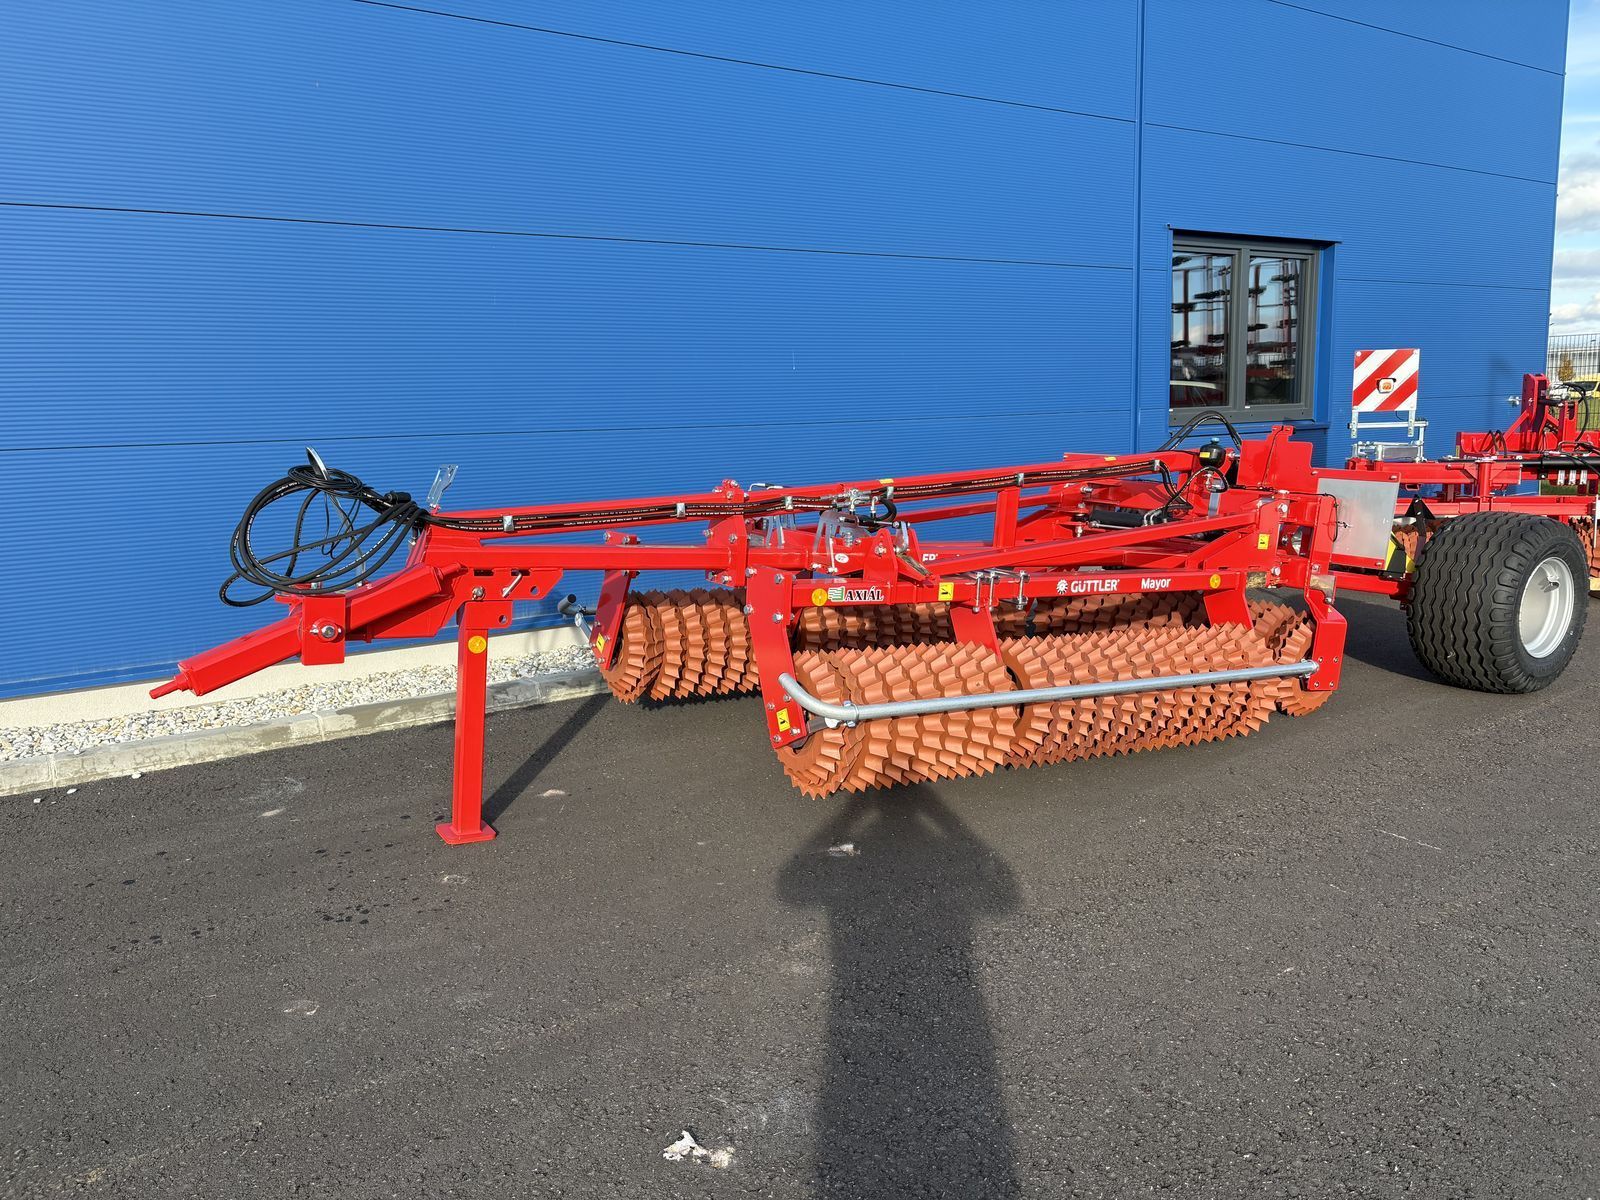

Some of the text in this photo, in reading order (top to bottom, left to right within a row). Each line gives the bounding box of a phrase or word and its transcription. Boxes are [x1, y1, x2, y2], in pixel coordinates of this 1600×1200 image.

[1070, 578, 1171, 593] GÜTTLER Mayor
[845, 586, 884, 601] AXIÁL
